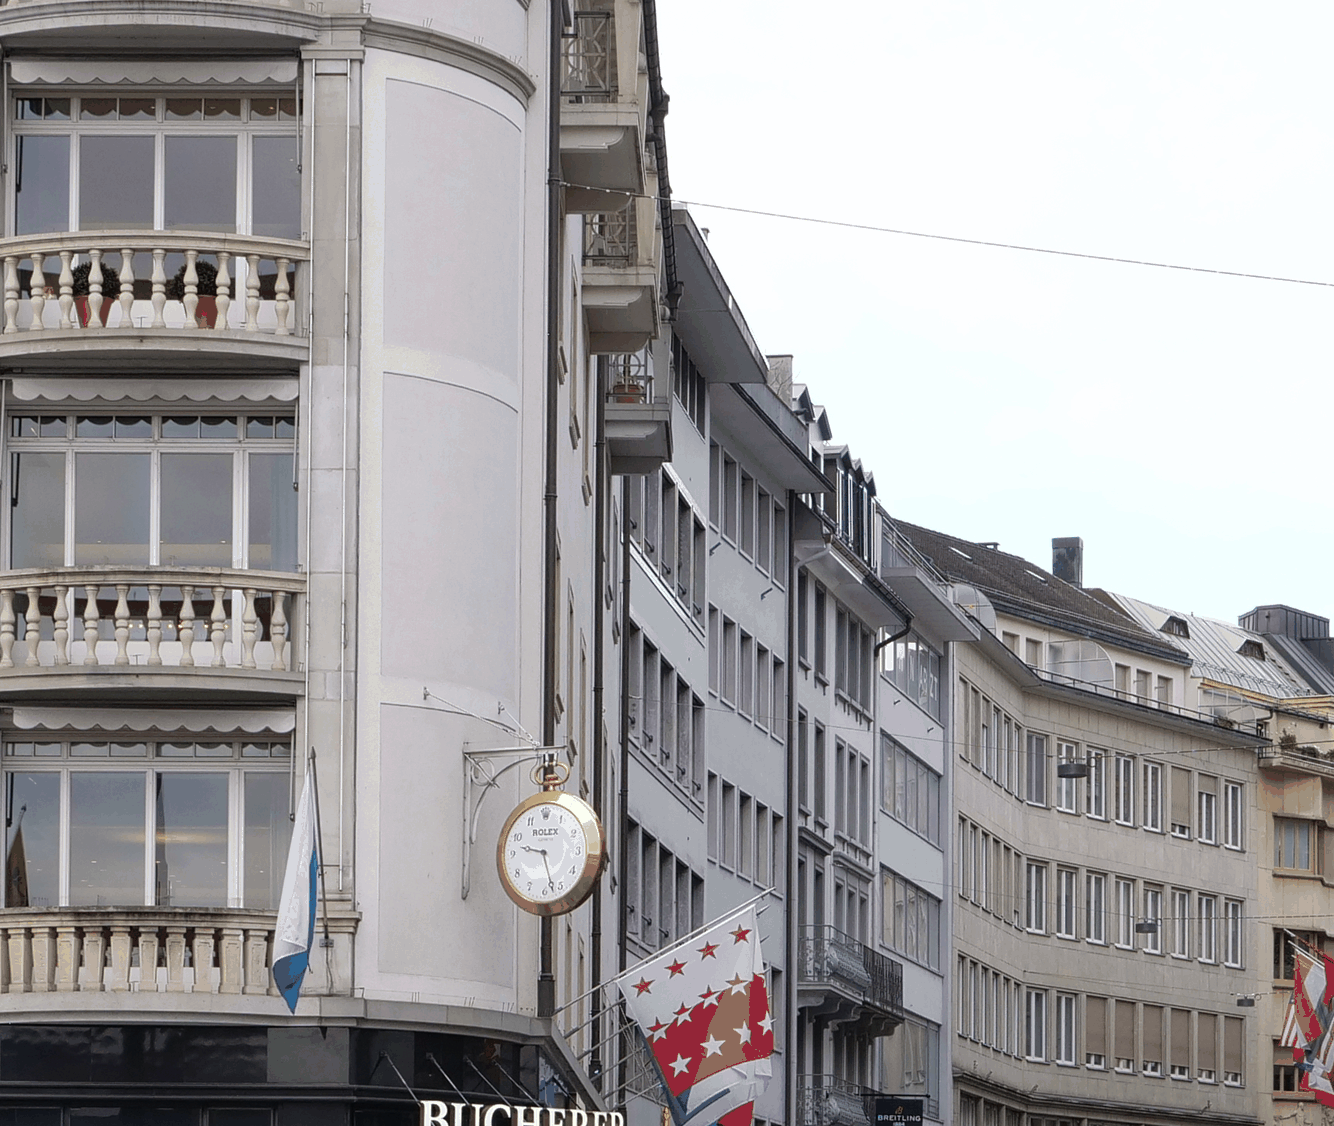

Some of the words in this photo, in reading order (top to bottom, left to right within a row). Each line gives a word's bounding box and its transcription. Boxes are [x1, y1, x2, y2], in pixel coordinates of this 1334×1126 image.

[513, 832, 523, 842] 10
[532, 828, 559, 837] ROLEX
[570, 828, 577, 838] 2
[510, 850, 516, 859] 9
[575, 846, 581, 856] 3
[514, 868, 520, 878] 8
[569, 864, 576, 875] 4
[527, 881, 533, 891] 7
[542, 886, 548, 896] 6
[557, 881, 564, 891] 5
[877, 1114, 921, 1122] BREITLING
